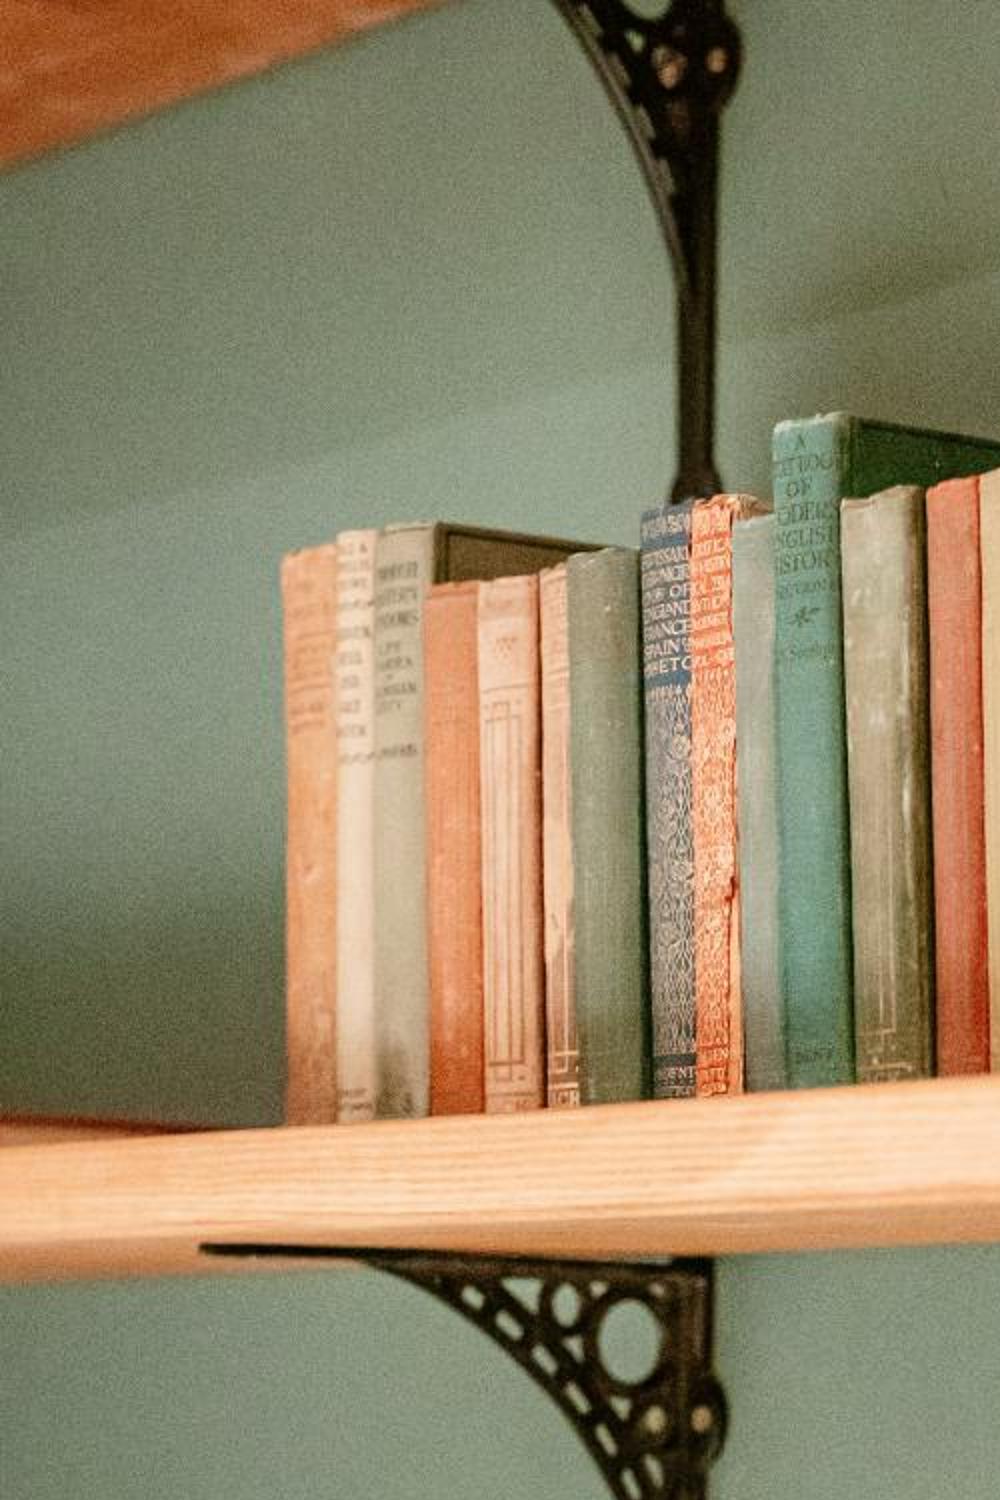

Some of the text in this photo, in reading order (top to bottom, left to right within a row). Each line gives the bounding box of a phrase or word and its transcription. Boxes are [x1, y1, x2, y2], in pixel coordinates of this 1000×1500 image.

[785, 478, 812, 498] OF
[773, 527, 837, 550] NGLIS
[774, 552, 832, 576] ISTOR
